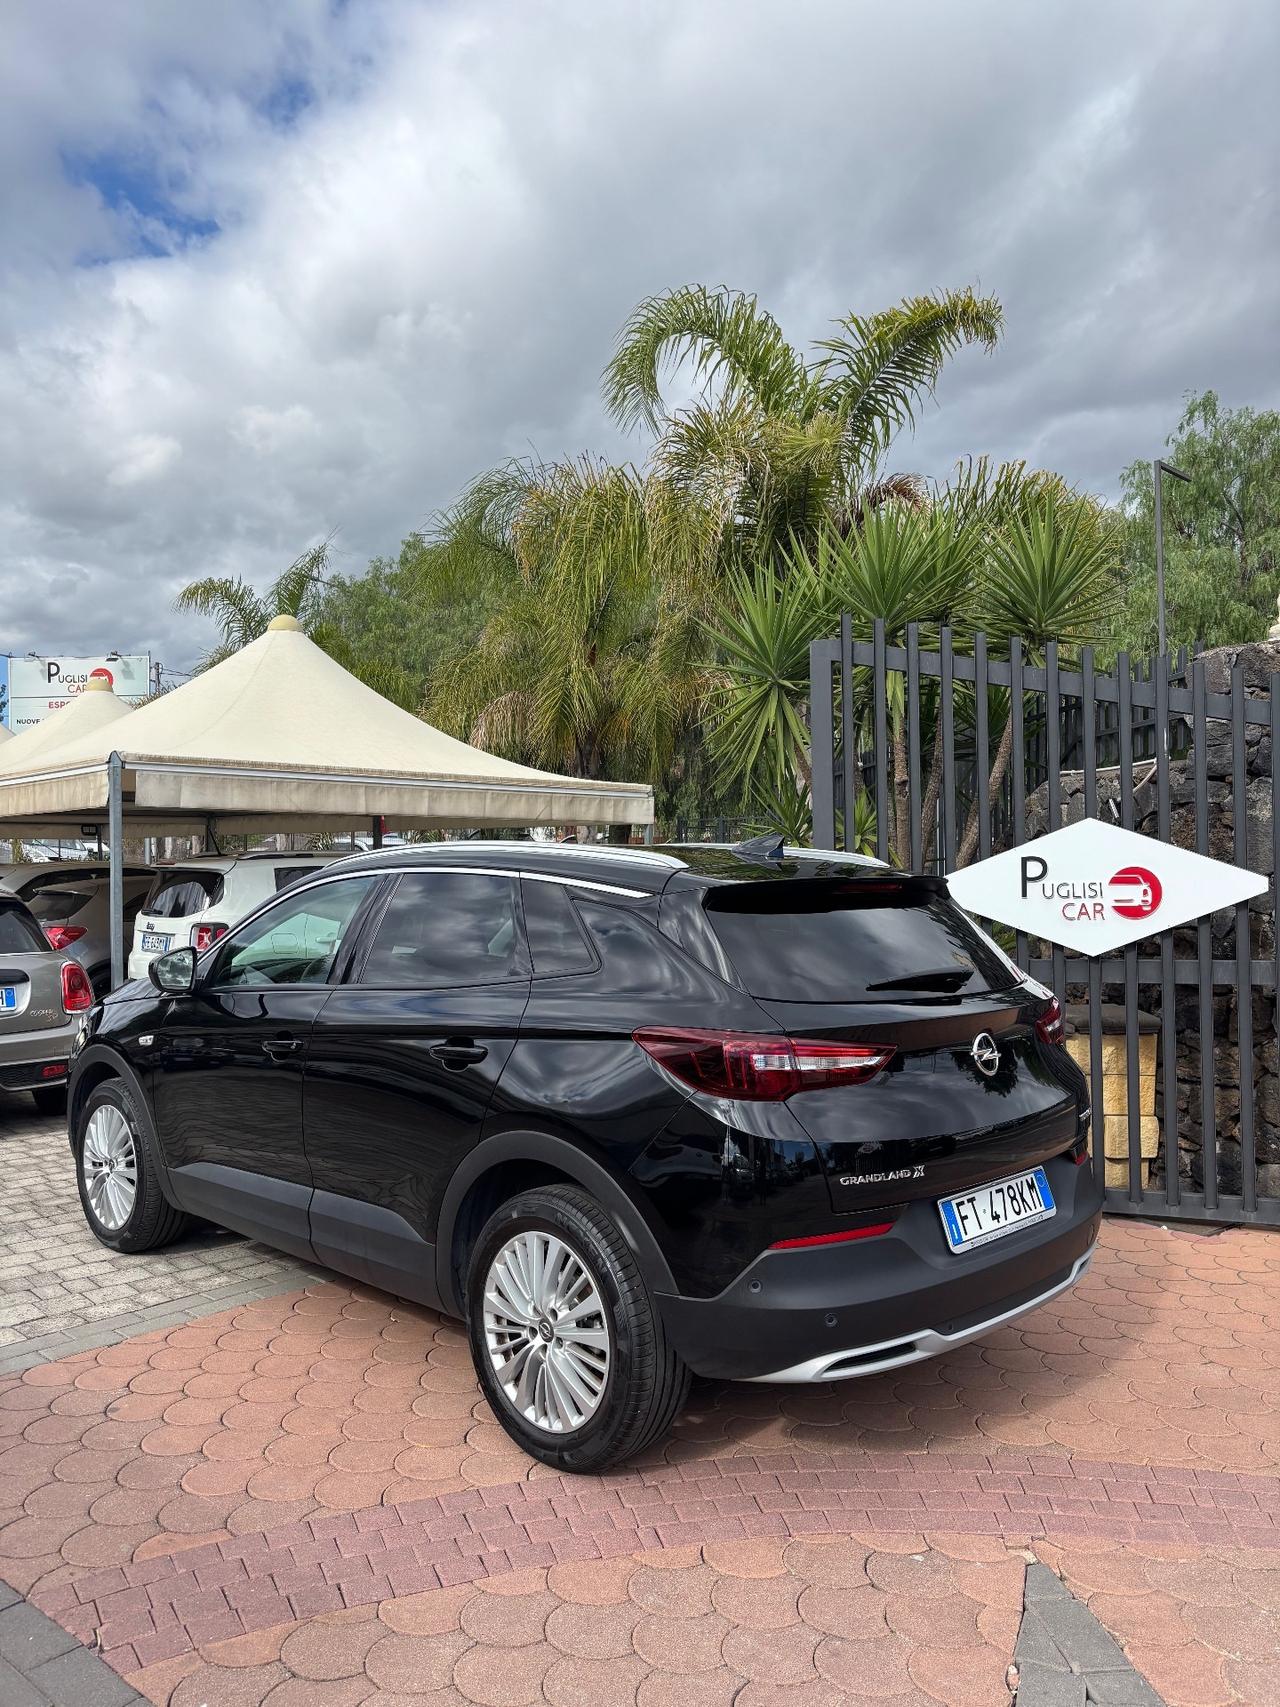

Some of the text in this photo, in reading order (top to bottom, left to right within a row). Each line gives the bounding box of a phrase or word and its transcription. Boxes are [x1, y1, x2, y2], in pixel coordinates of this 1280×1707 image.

[47, 662, 88, 683] PUGLISI
[1020, 856, 1105, 899] PUGLISI
[1062, 902, 1106, 921] CAR
[839, 1164, 926, 1186] GRANDLAND X
[955, 1197, 983, 1236] FT
[988, 1176, 1043, 1224] 478KM
